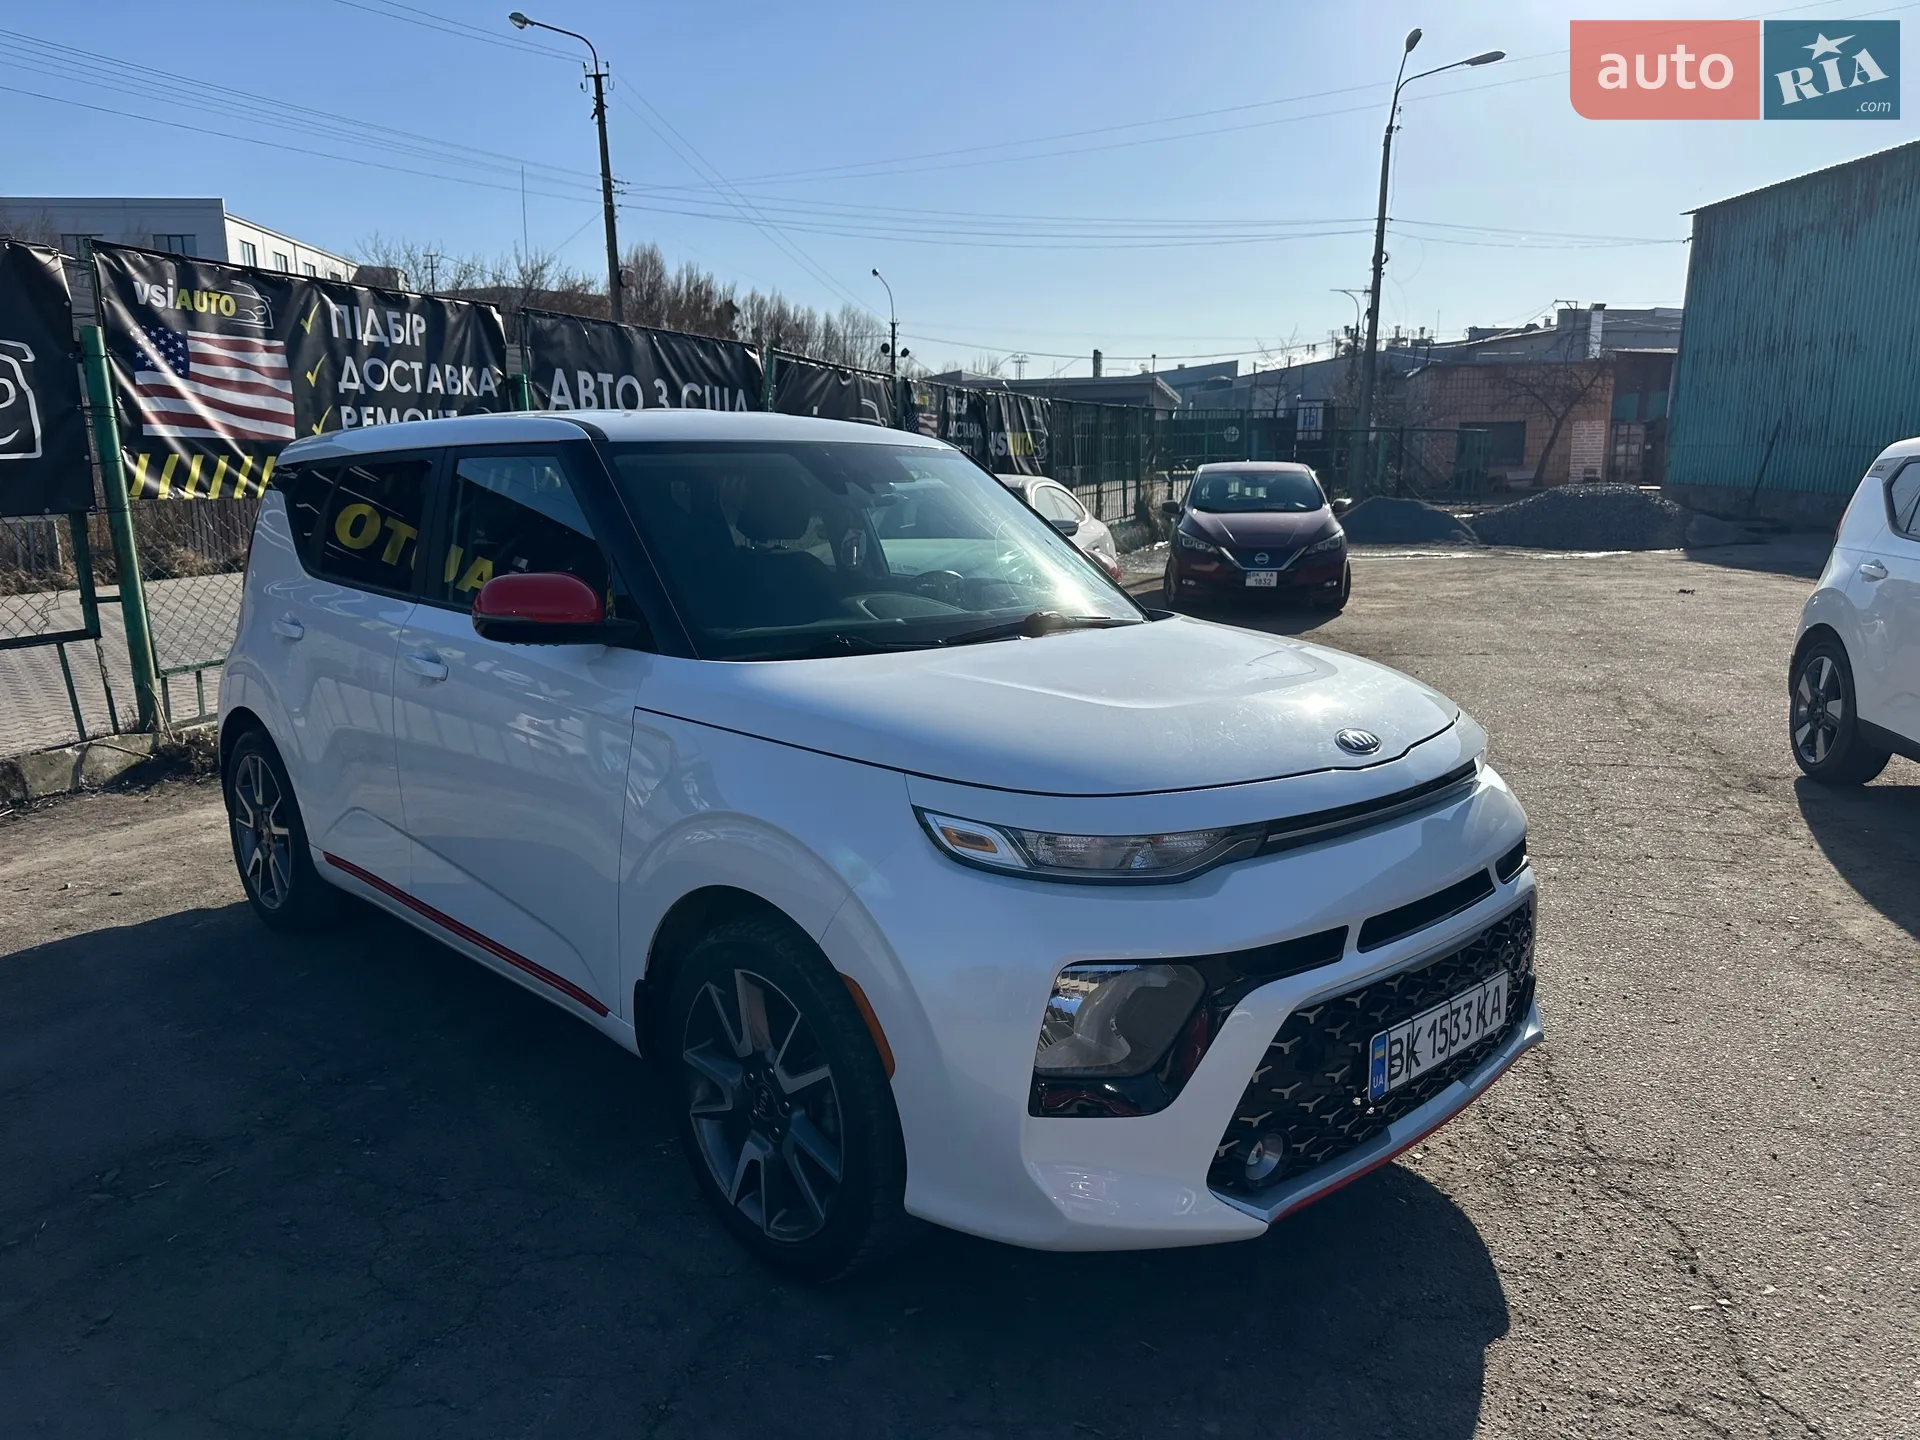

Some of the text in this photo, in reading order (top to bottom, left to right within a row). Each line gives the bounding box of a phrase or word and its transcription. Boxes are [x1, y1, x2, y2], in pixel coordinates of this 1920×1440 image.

[330, 304, 427, 348] ПІДБІР
[338, 355, 499, 398] ДОСТАВКА
[548, 367, 645, 411] АВТО
[1389, 984, 1501, 1081] BK 1533 KA
[1372, 1077, 1384, 1089] UA
